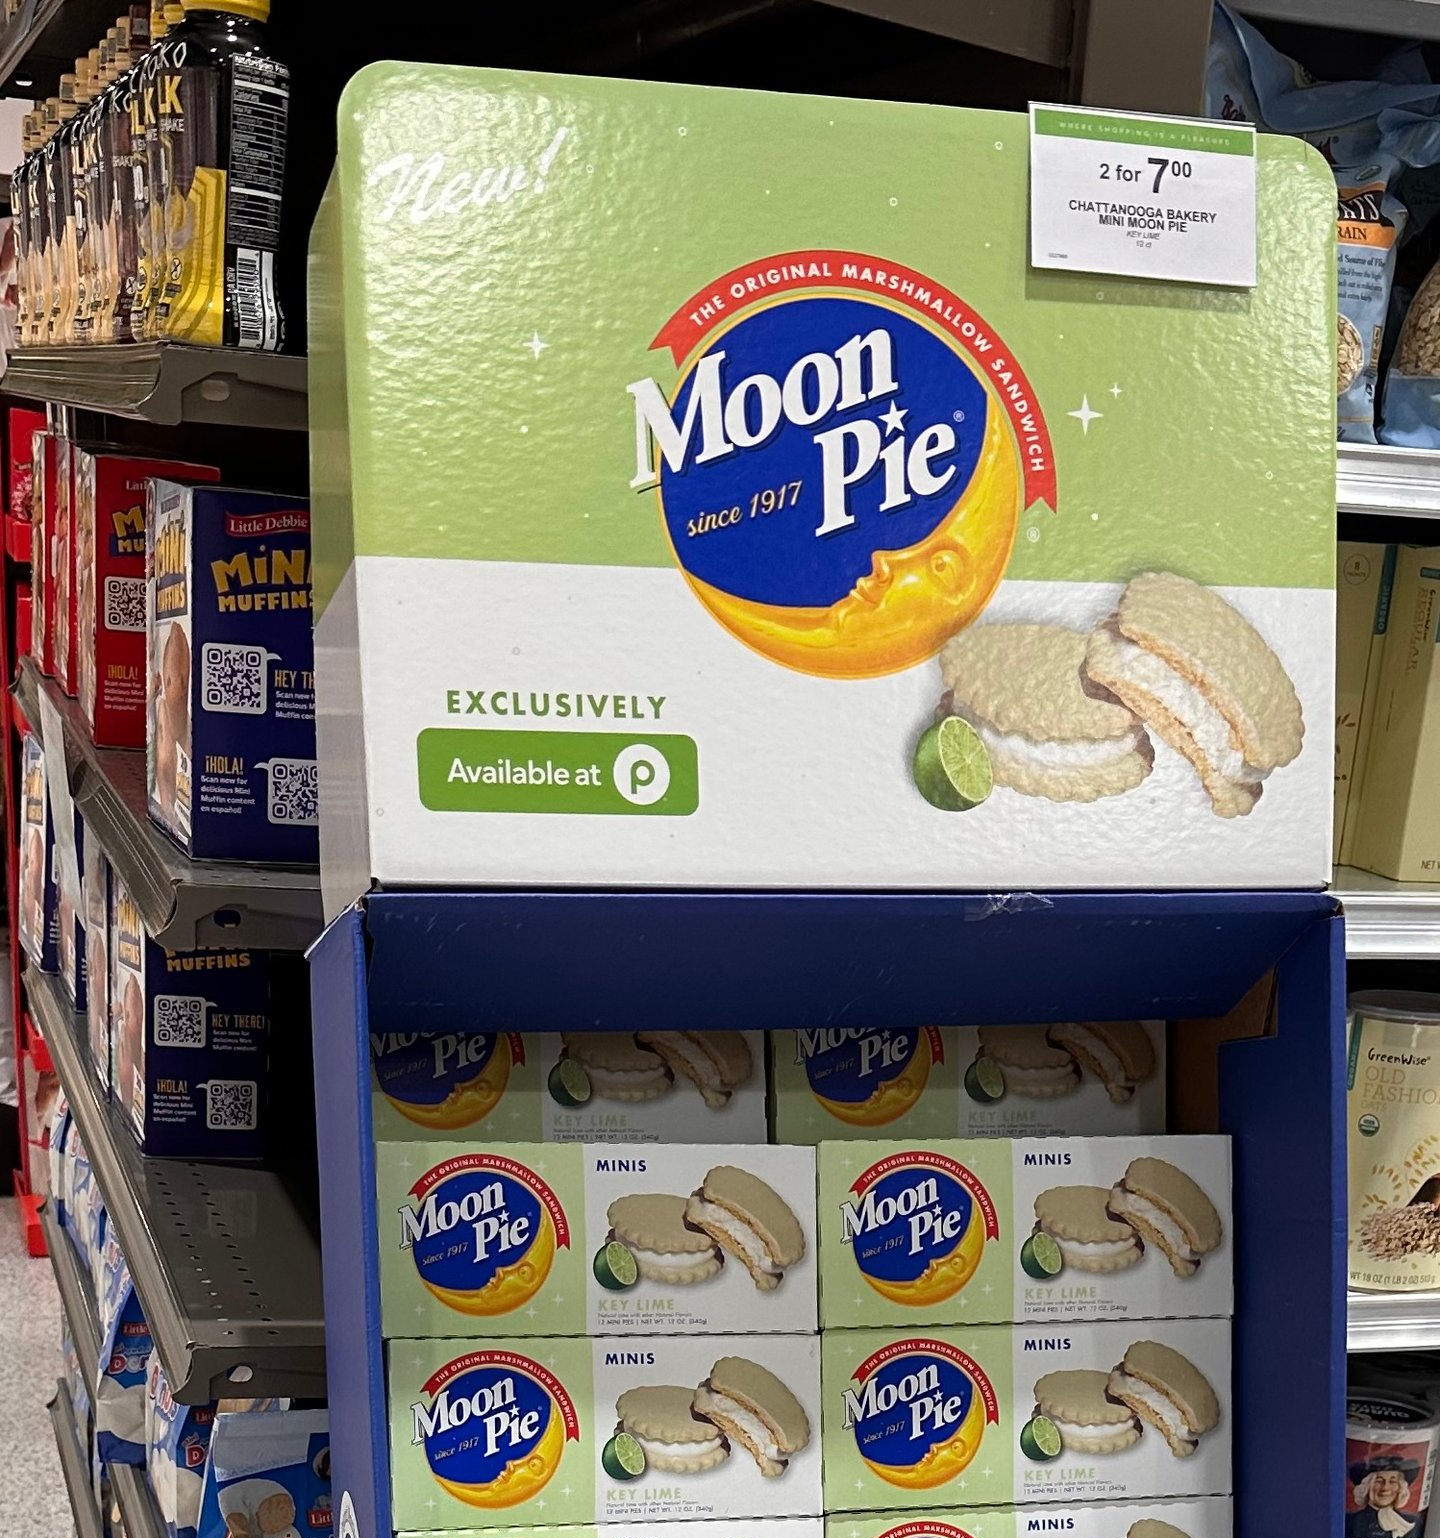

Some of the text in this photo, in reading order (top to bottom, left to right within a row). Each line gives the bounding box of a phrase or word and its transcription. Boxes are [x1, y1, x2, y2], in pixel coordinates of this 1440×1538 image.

[367, 127, 569, 224] New!
[1099, 163, 1110, 180] 2
[1115, 165, 1142, 183] for
[1068, 199, 1217, 224] CHATTANOOGA BAKERY
[1098, 213, 1188, 233] MINI MOON PIE
[690, 262, 1047, 475] THE ORIGINAL MARSHMALLOW SANDWICH
[626, 327, 899, 490] Moon
[813, 399, 958, 540] Pie
[686, 480, 803, 540] since 1917
[230, 515, 308, 533] Little Debbie
[274, 669, 298, 689] HEY
[445, 691, 667, 721] EXCLUSIVELY
[446, 755, 602, 791] Available at
[167, 952, 251, 973] MUFFINS
[212, 1013, 265, 1030] HEY THERE!
[1367, 1047, 1428, 1066] GreenWise
[1365, 1065, 1406, 1085] OLD
[1362, 1082, 1440, 1105] FASHIO
[596, 1157, 646, 1171] MINIS
[1024, 1152, 1071, 1164] MINIS
[399, 1182, 506, 1248] Moon
[840, 1177, 939, 1242] Moon
[472, 1210, 529, 1264] Pie
[908, 1204, 961, 1256] Pie
[605, 1351, 654, 1364] MINIS
[1024, 1338, 1070, 1350] MINIS
[842, 1364, 940, 1429] Moon
[411, 1377, 516, 1444] Moon
[909, 1390, 961, 1441] Pie
[484, 1405, 539, 1458] Pie
[1028, 1517, 1074, 1530] MINIS
